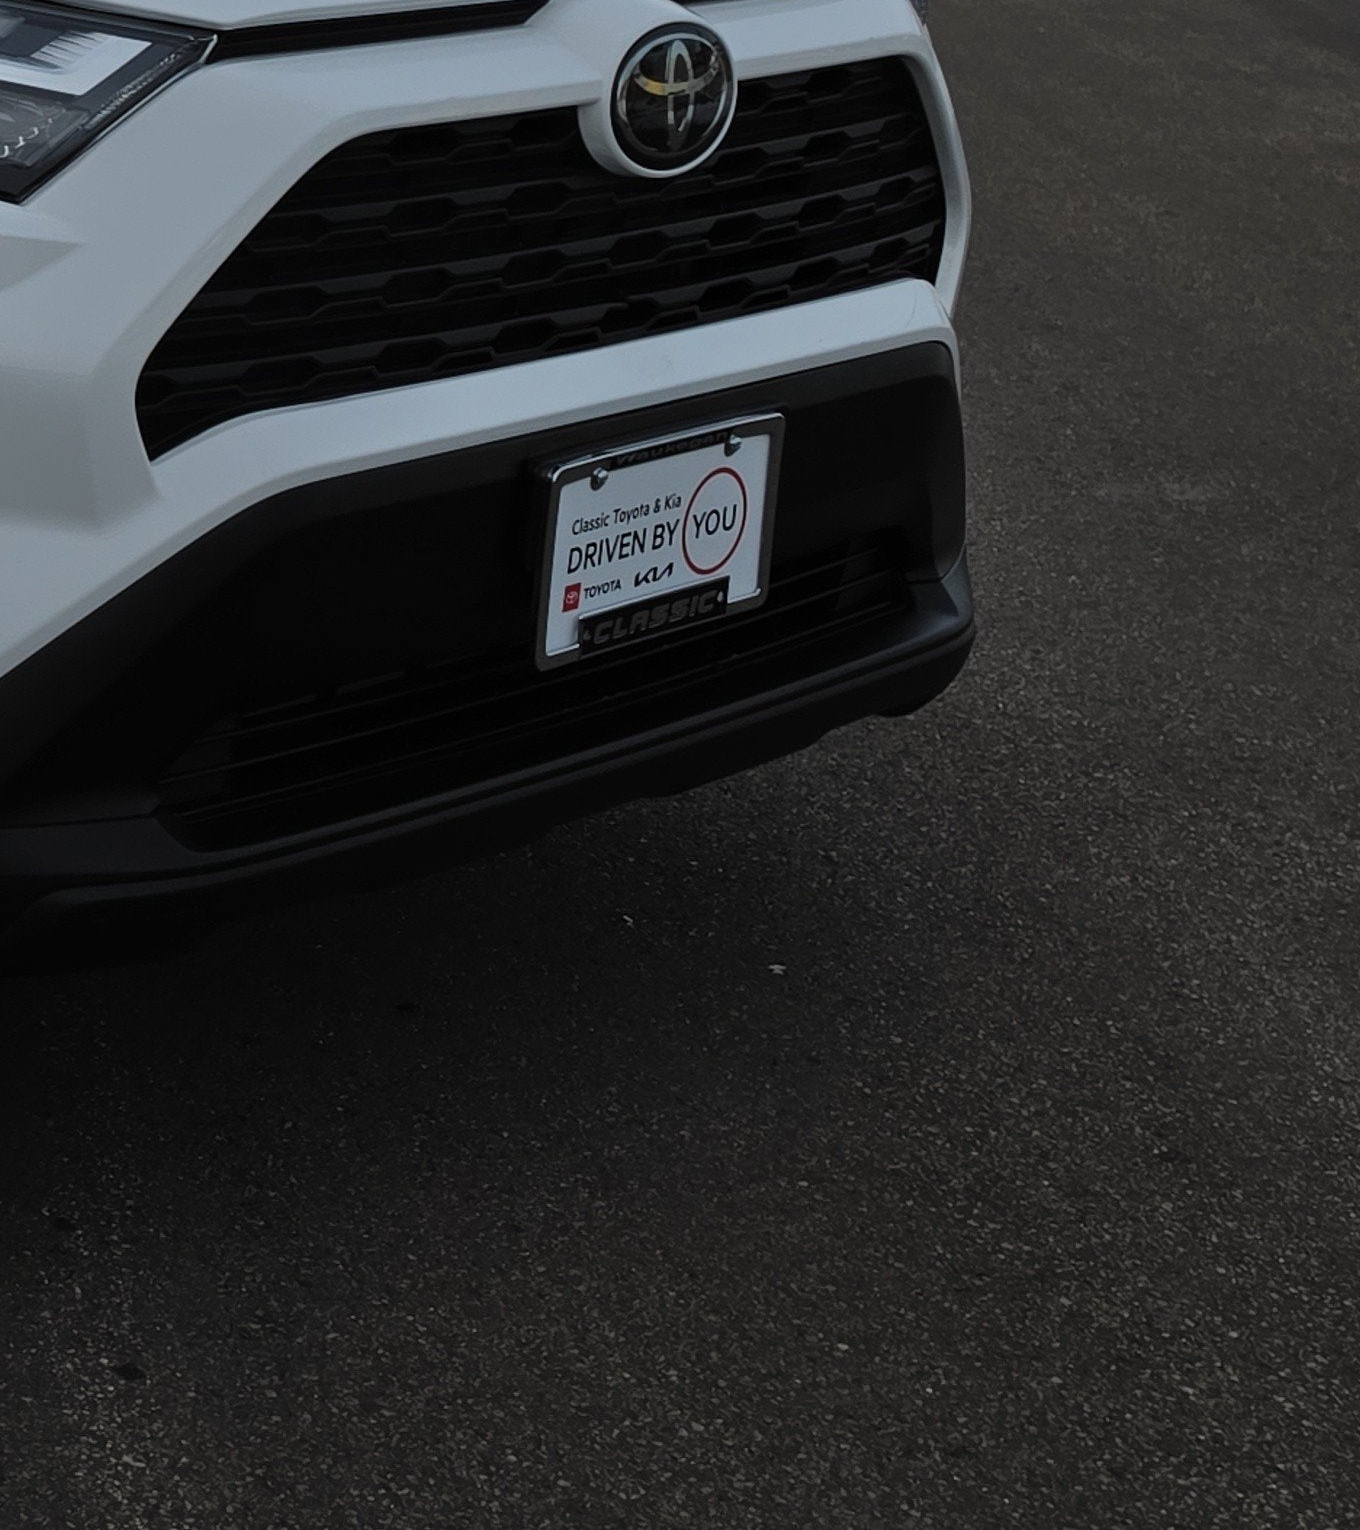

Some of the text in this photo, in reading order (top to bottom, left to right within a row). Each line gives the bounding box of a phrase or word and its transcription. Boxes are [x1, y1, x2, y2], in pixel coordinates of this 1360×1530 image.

[572, 493, 682, 536] Classic Toyota & Kia
[567, 504, 737, 575] DRIVEN BY YOU
[584, 579, 622, 600] TOYOTA
[594, 589, 719, 644] CLASSIC
